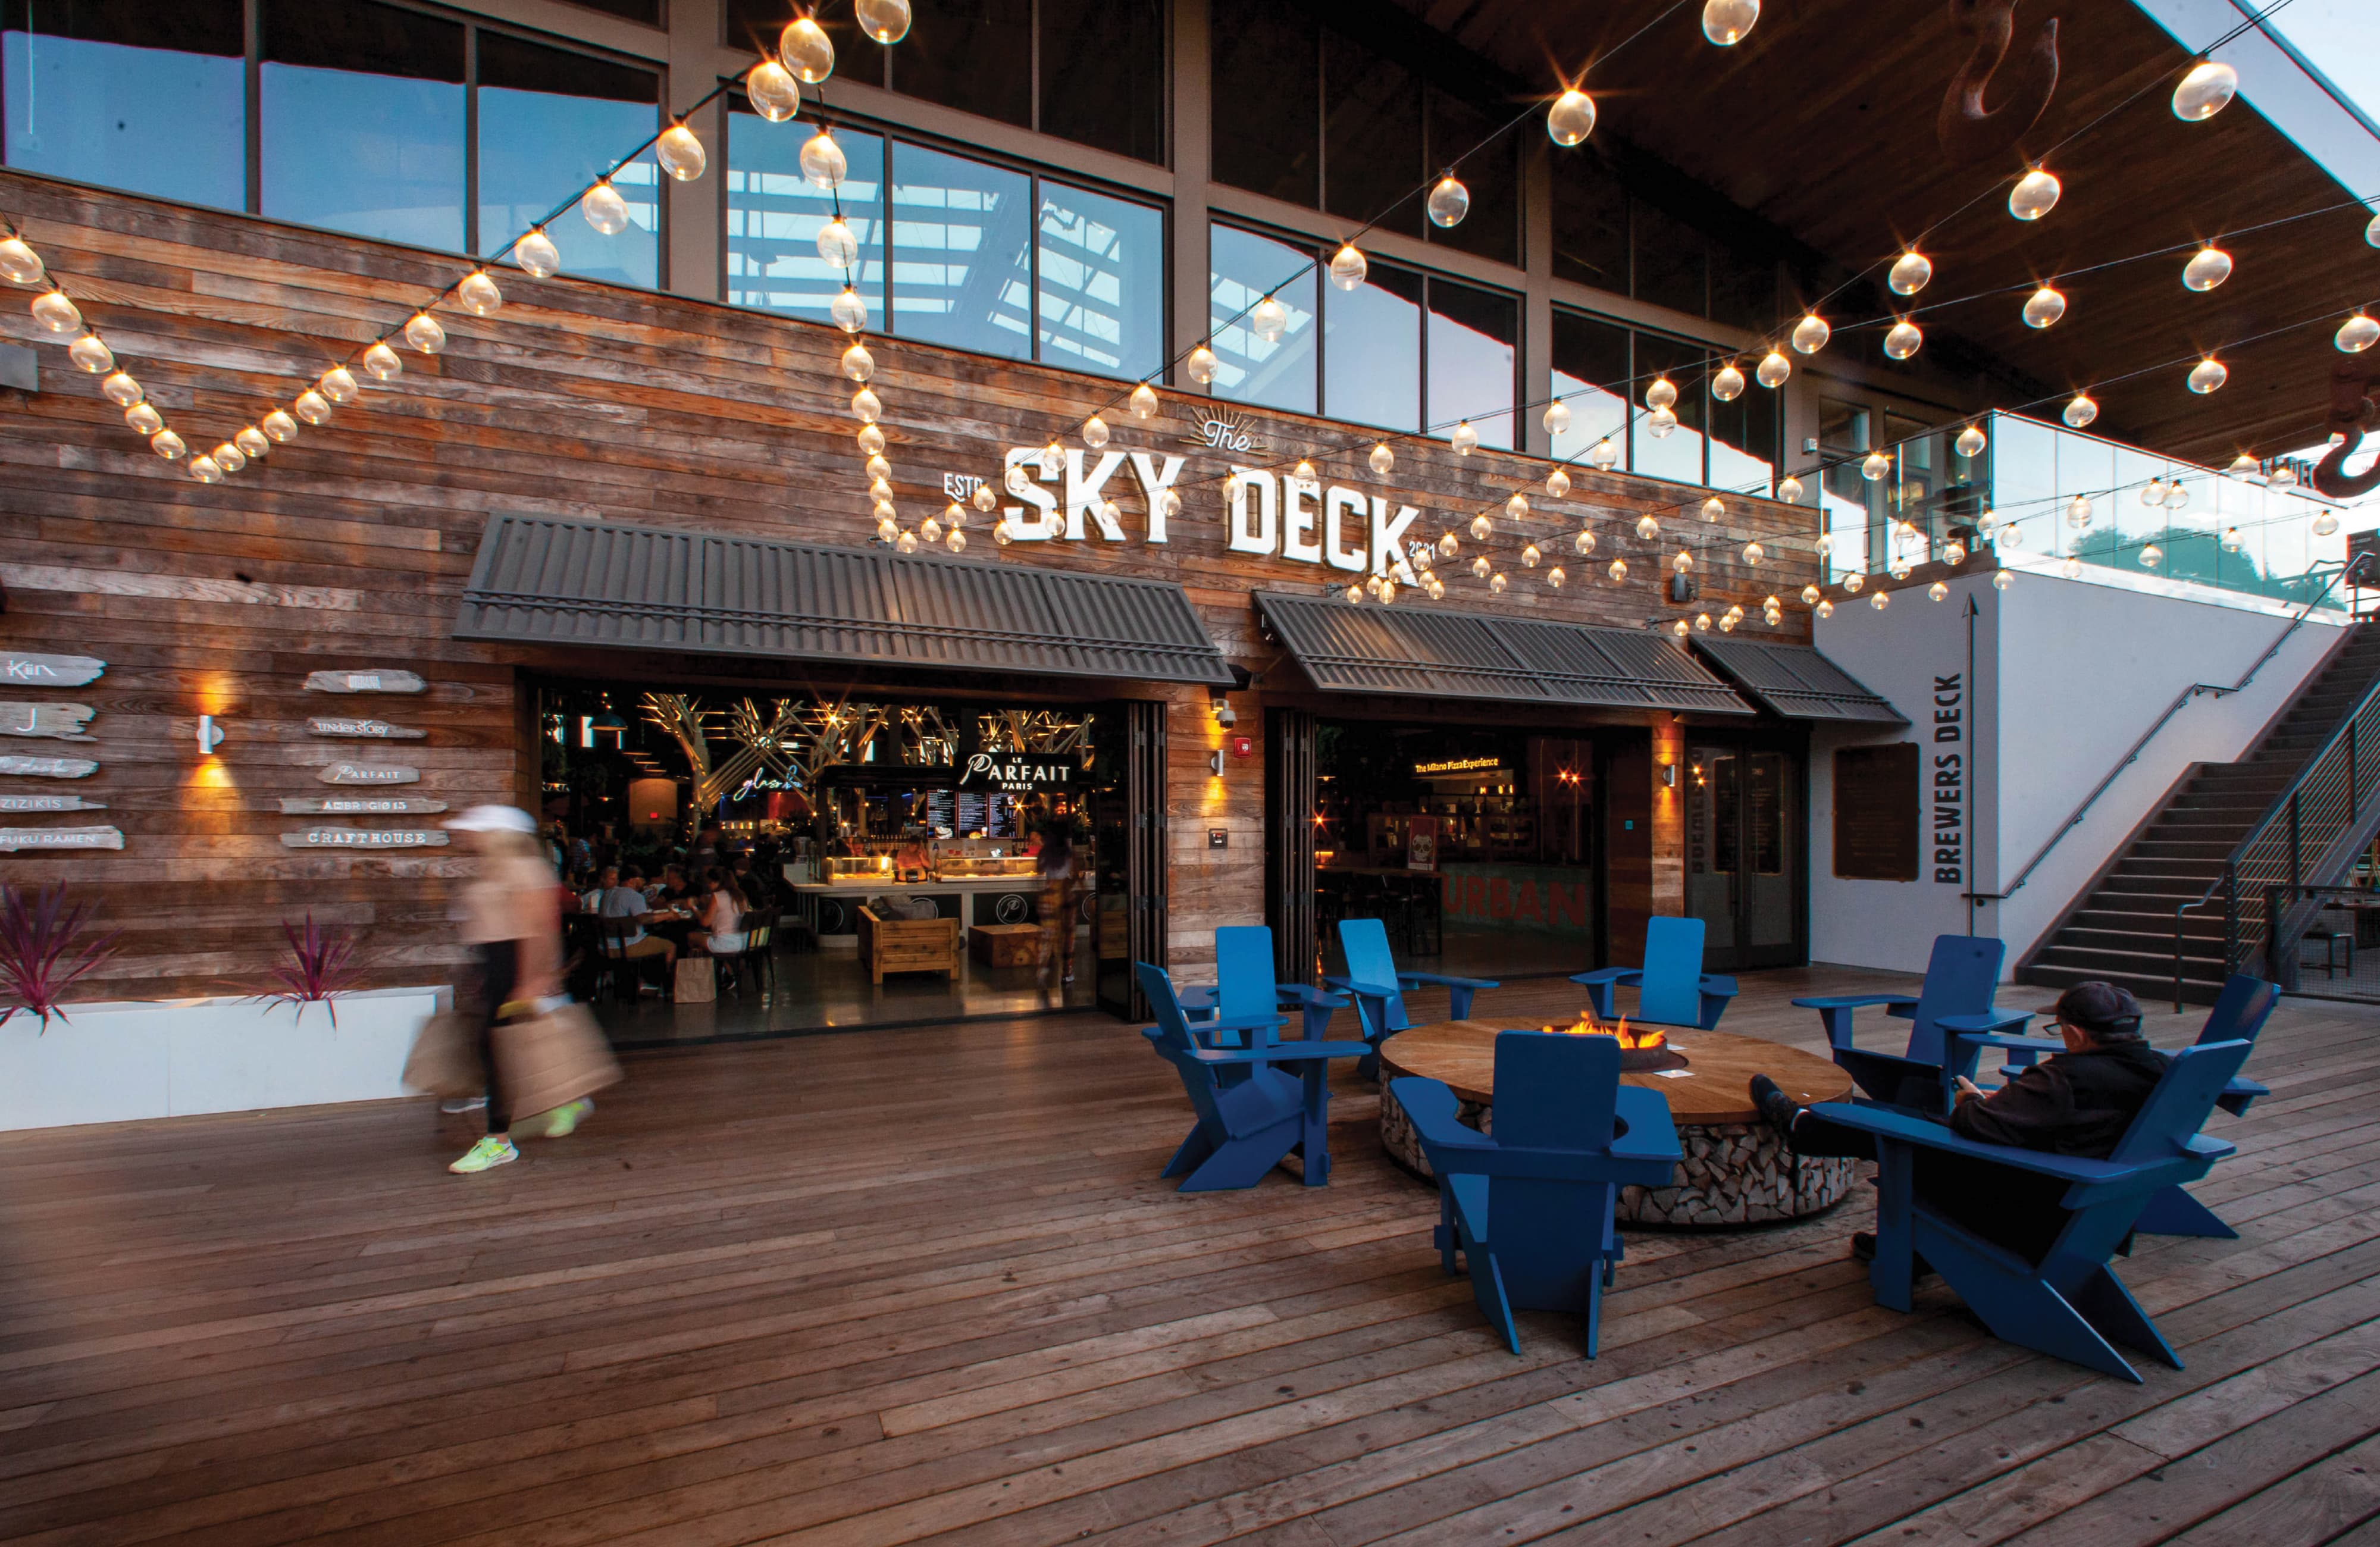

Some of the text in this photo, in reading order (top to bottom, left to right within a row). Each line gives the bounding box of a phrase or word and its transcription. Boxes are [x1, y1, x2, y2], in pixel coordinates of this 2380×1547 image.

[1204, 419, 1252, 452] The
[1003, 447, 1420, 589] SKY DECK
[7, 660, 58, 679] Kiin
[334, 765, 400, 780] PARFAIT
[960, 753, 1070, 785] PARFAIT
[1415, 757, 1499, 773] The Milano Pizza Experience
[1934, 673, 1962, 884] BREWERS DECK
[1, 798, 62, 809] ZIZIKIS
[43, 834, 96, 844] RAMEN
[1441, 875, 1586, 927] URBAN
